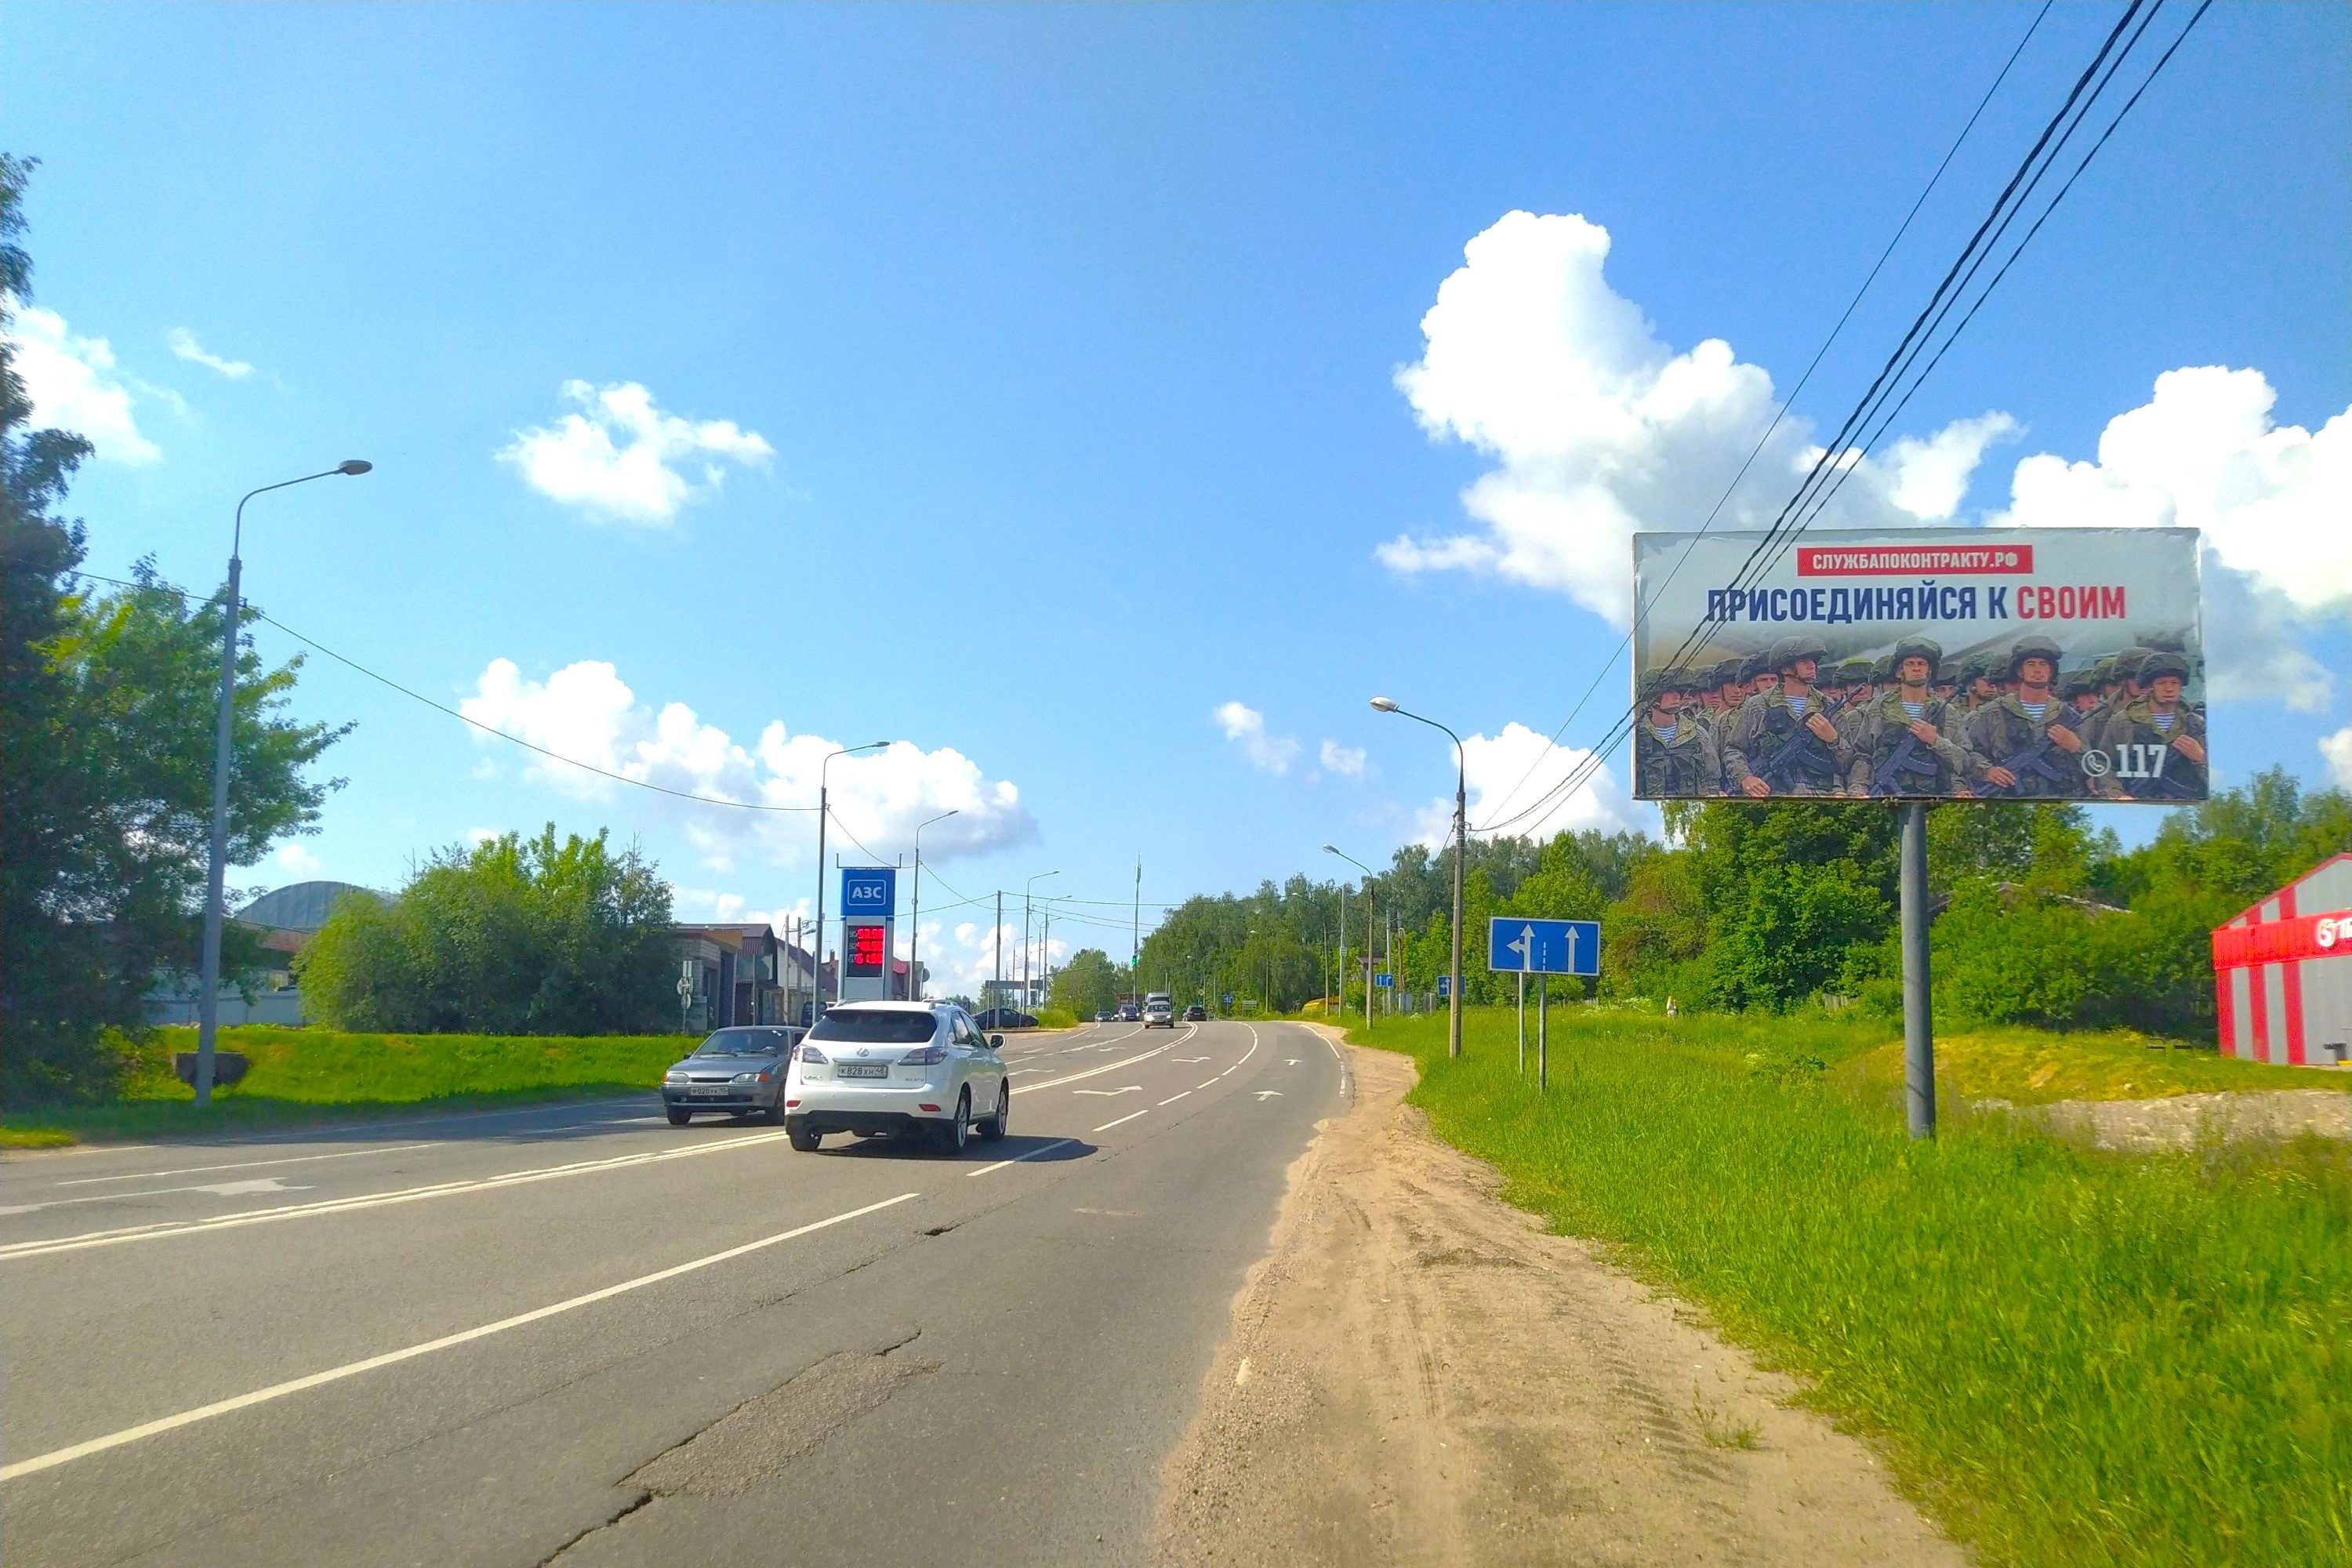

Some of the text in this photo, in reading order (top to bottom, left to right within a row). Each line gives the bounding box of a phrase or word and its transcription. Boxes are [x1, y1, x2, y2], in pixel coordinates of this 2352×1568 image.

[1812, 551, 2019, 570] СЛУЖБАПОКОНТРАКТУ.РФ
[1708, 579, 2126, 624] ПРИСОЕДИНЯЙСЯ К СВОИМ
[2115, 743, 2168, 778] 117
[851, 886, 882, 899] АЗС
